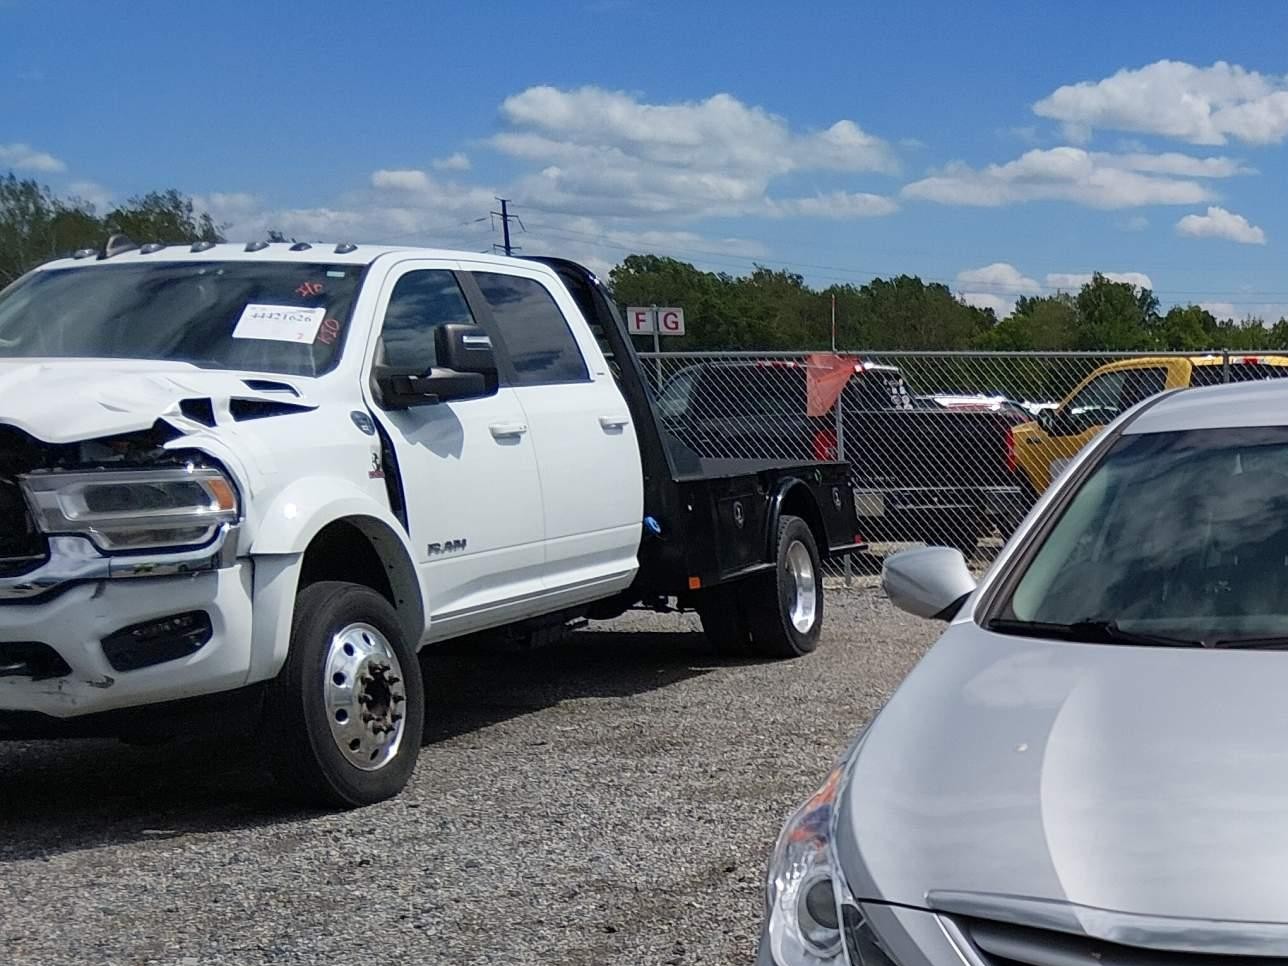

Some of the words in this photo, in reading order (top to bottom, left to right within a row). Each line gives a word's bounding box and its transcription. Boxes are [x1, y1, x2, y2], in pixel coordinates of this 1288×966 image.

[635, 312, 646, 330] F
[663, 312, 679, 330] G
[427, 538, 467, 556] RAM
